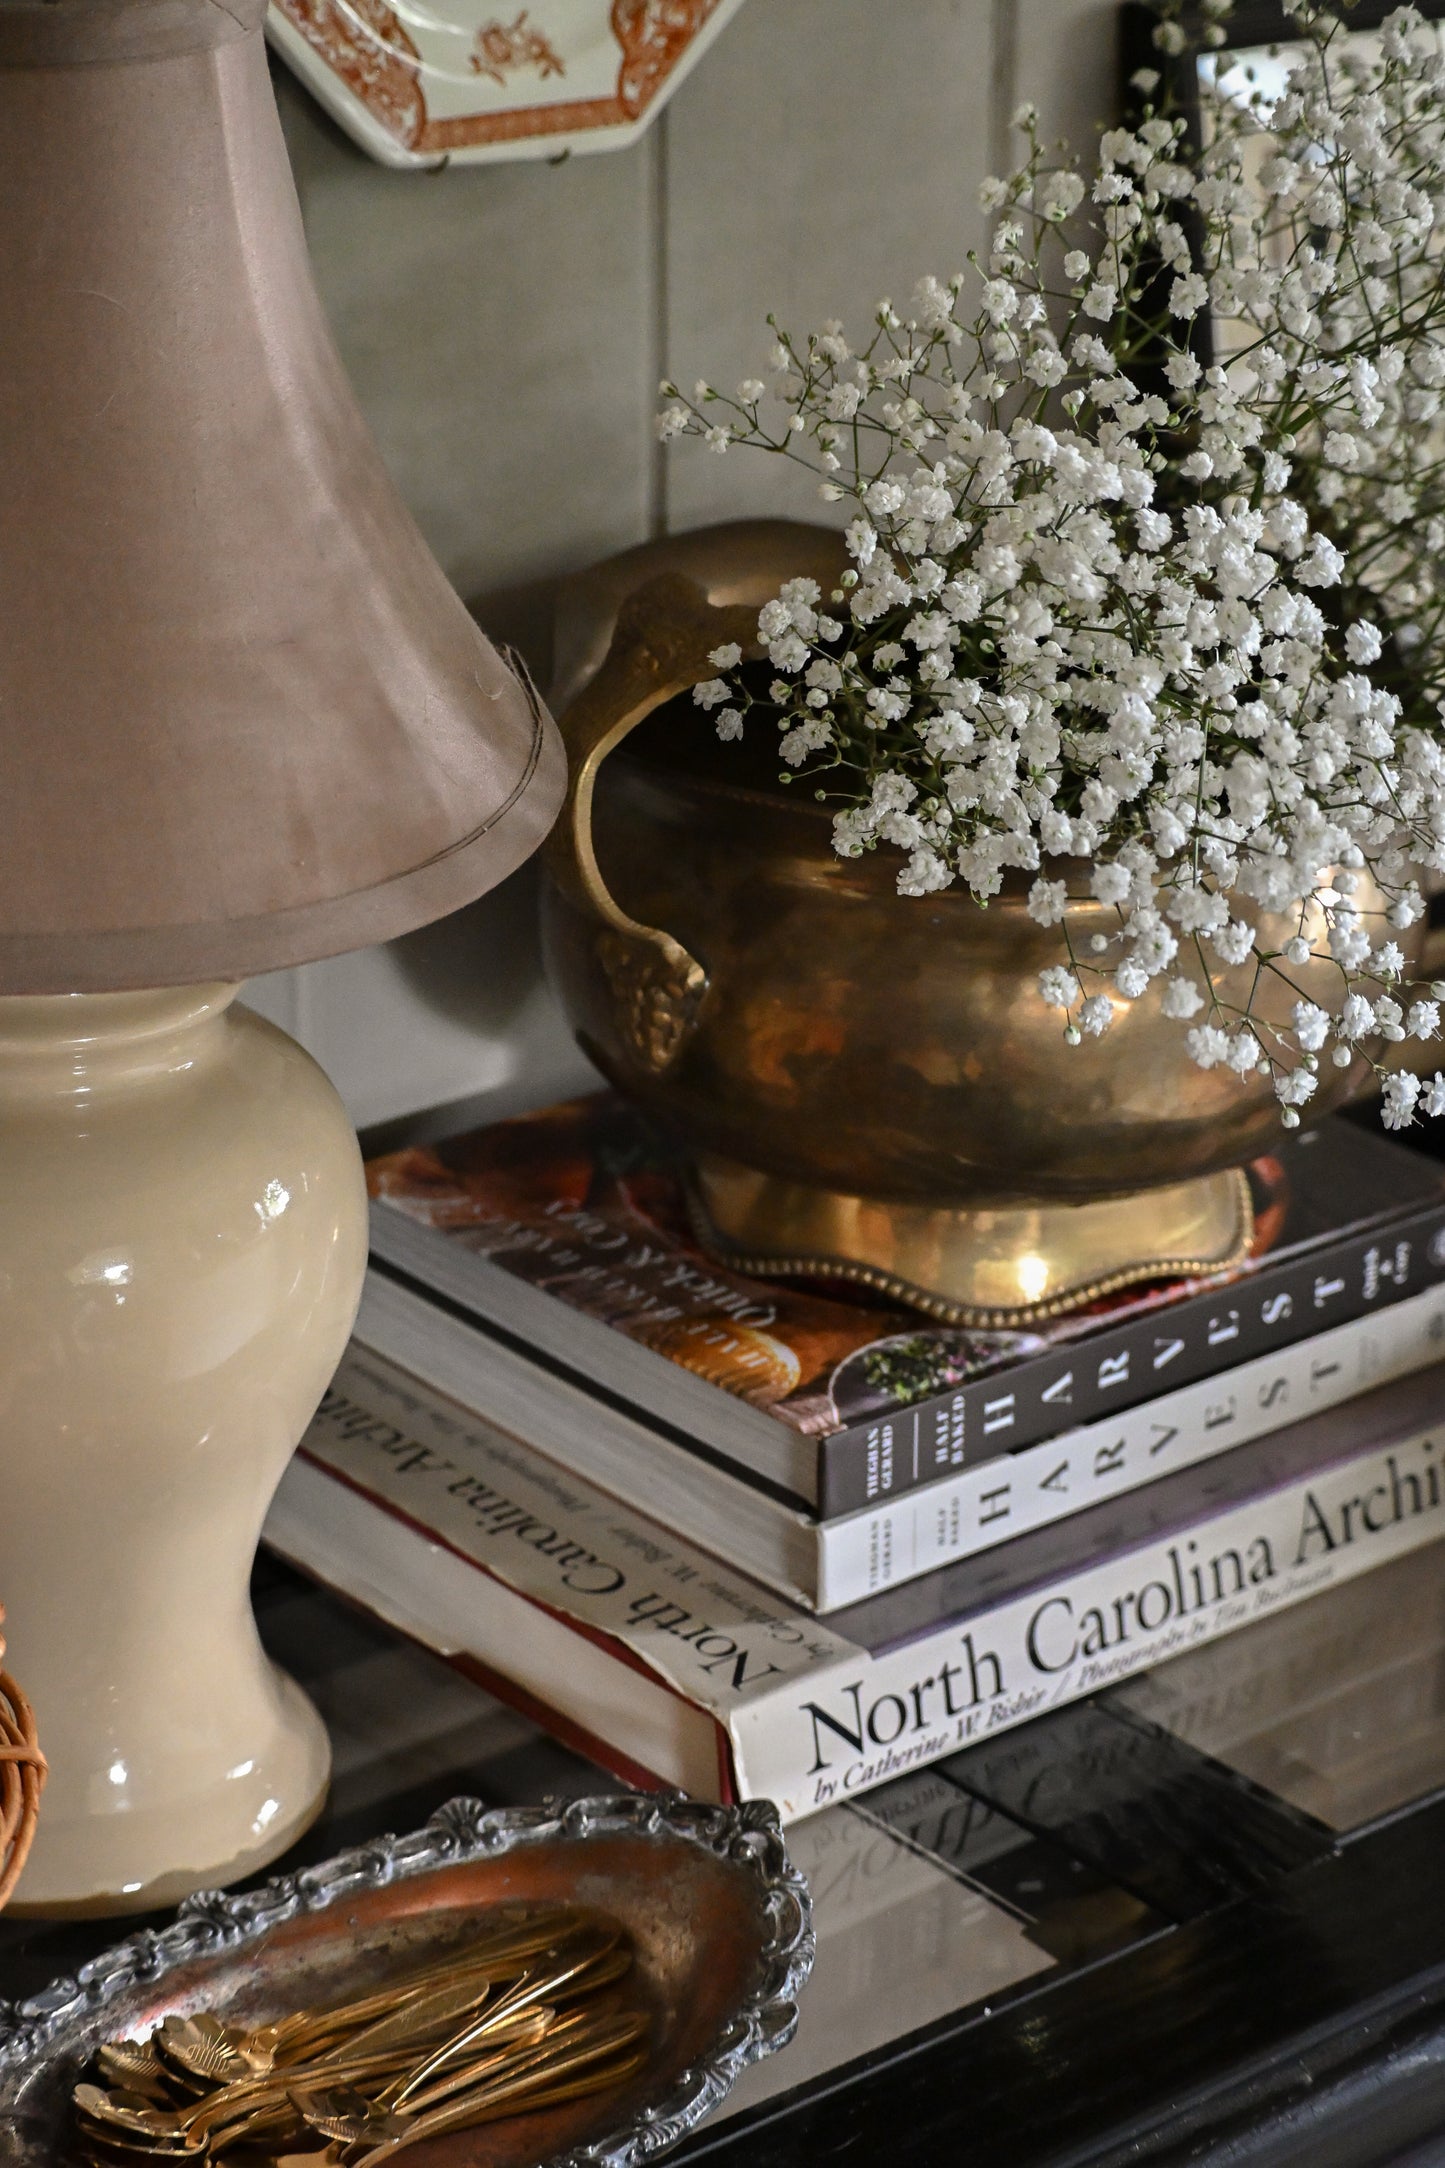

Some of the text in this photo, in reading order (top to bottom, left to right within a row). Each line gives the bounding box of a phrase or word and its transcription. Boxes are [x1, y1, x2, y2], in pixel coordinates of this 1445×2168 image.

[983, 1276, 1346, 1435] HARVEST
[881, 1424, 893, 1490] GERARD
[935, 1410, 949, 1464] HALF
[951, 1395, 965, 1465] BAKED
[978, 1357, 1342, 1527] HARVEST
[446, 1476, 626, 1595] Carolina
[627, 1592, 784, 1692] North
[798, 1634, 1005, 1776] North
[1026, 1535, 1275, 1674] Carolina
[813, 1777, 838, 1803] by
[843, 1730, 949, 1789] Catherine
[957, 1712, 979, 1741] W.
